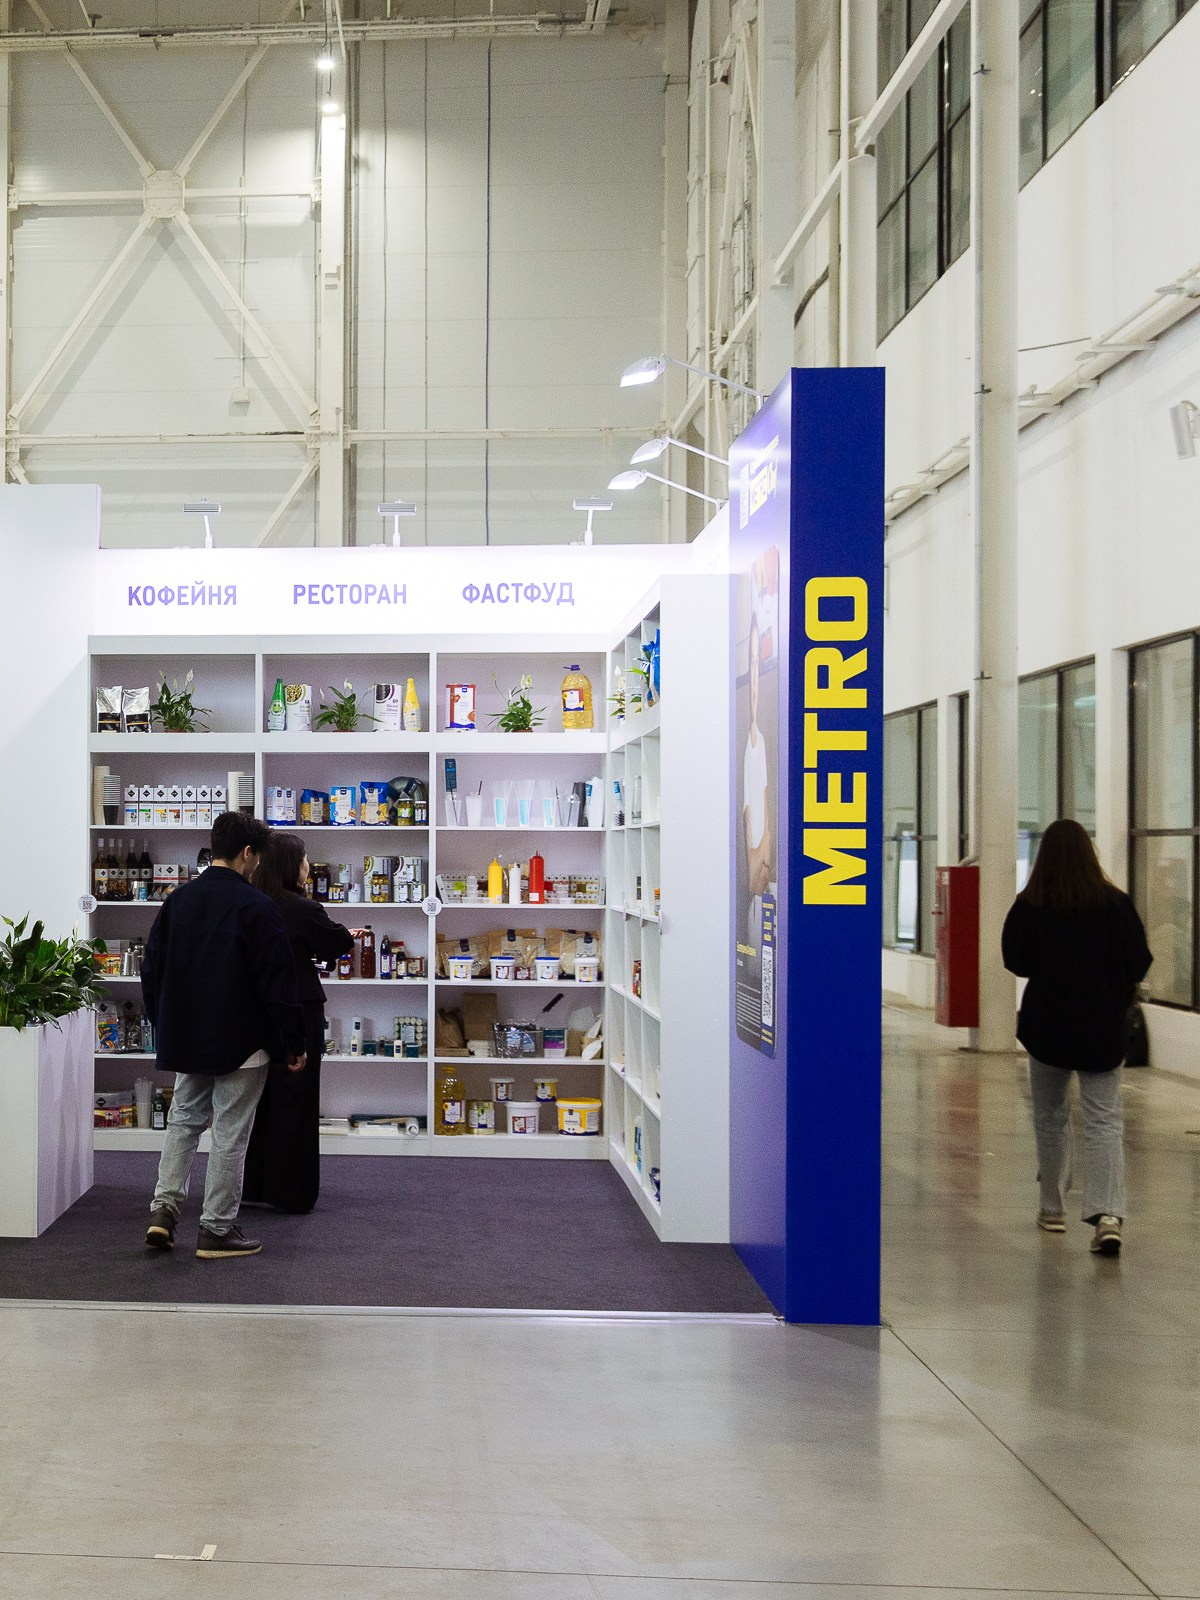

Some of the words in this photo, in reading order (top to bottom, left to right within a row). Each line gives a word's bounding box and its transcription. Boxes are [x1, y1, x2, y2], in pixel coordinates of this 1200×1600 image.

[128, 580, 237, 606] КОФЕЙНЯ
[293, 583, 407, 605] РЕСТОРАН
[462, 582, 575, 606] ФАСТФУД
[803, 577, 868, 905] METRO
